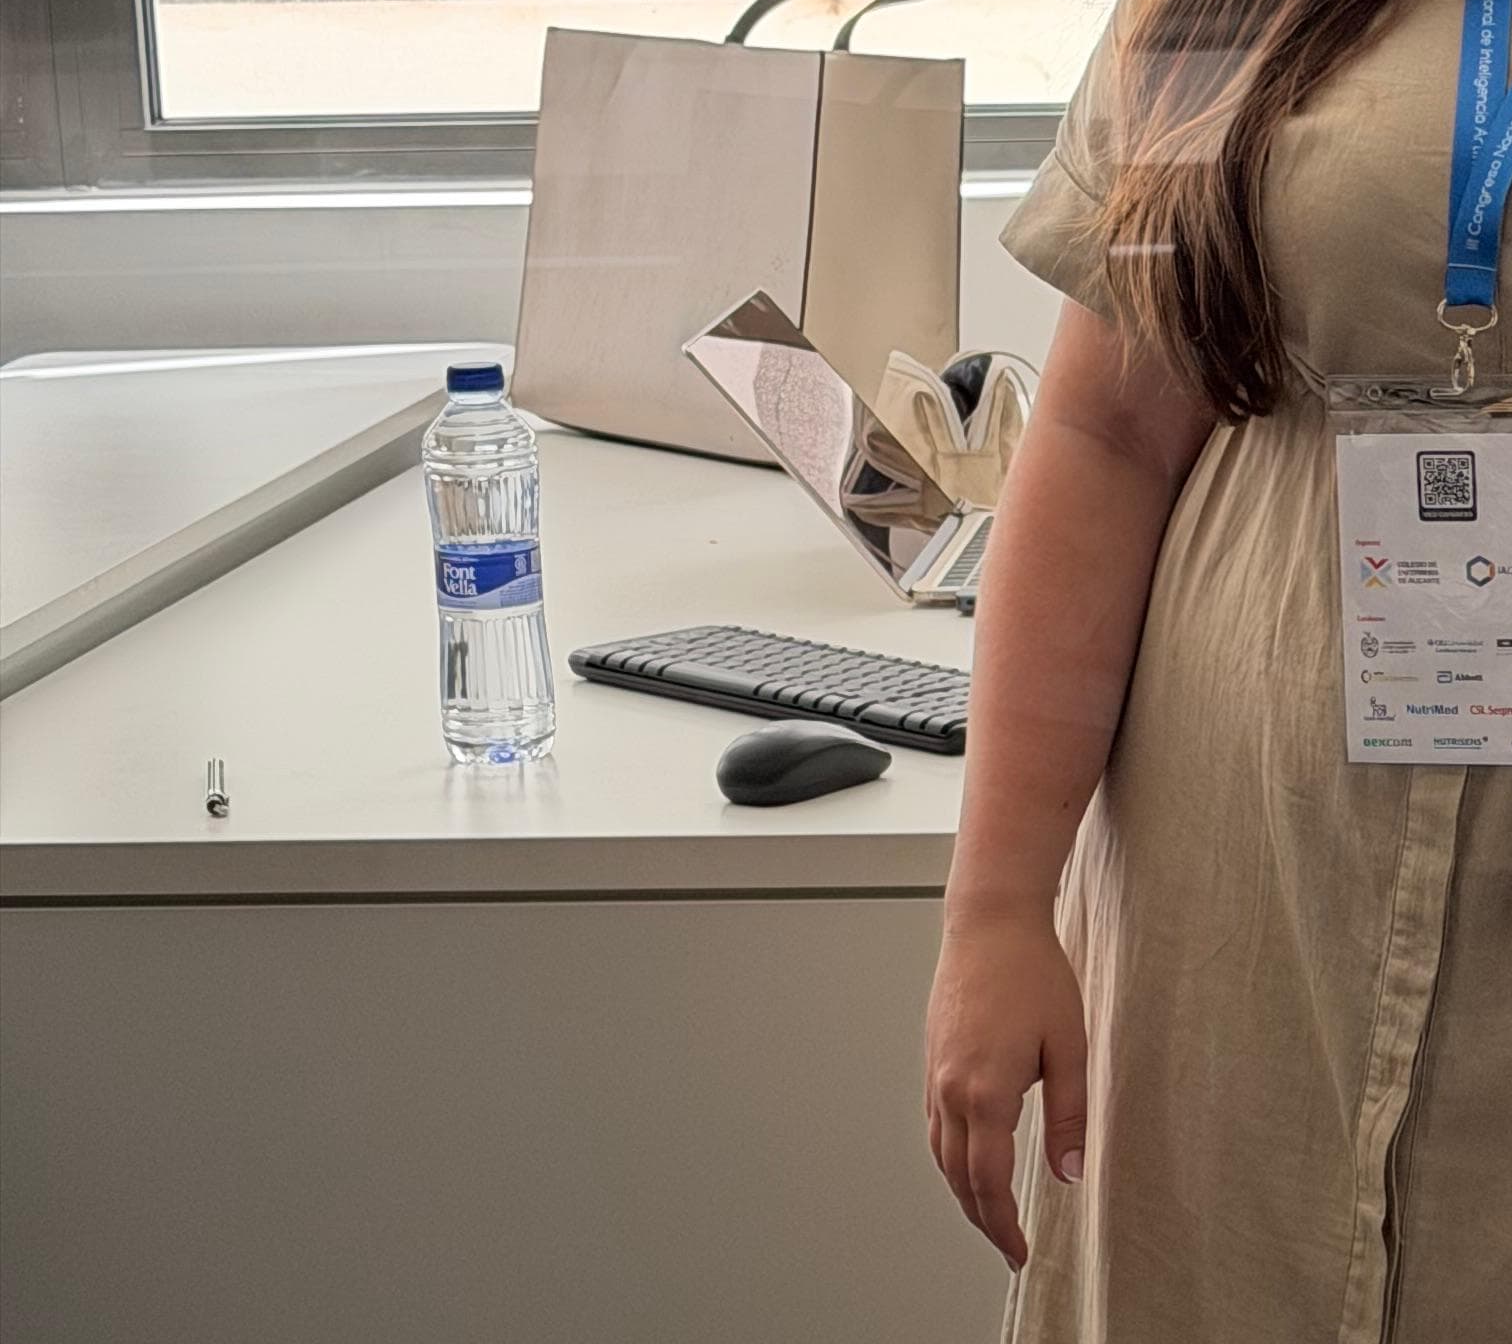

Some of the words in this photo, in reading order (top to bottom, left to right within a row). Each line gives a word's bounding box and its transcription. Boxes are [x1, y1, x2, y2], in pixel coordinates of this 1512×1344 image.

[1480, 29, 1494, 47] de
[1467, 160, 1502, 236] Congreso
[443, 562, 476, 580] Font
[444, 577, 477, 595] Vella
[1406, 703, 1459, 715] NutriMed
